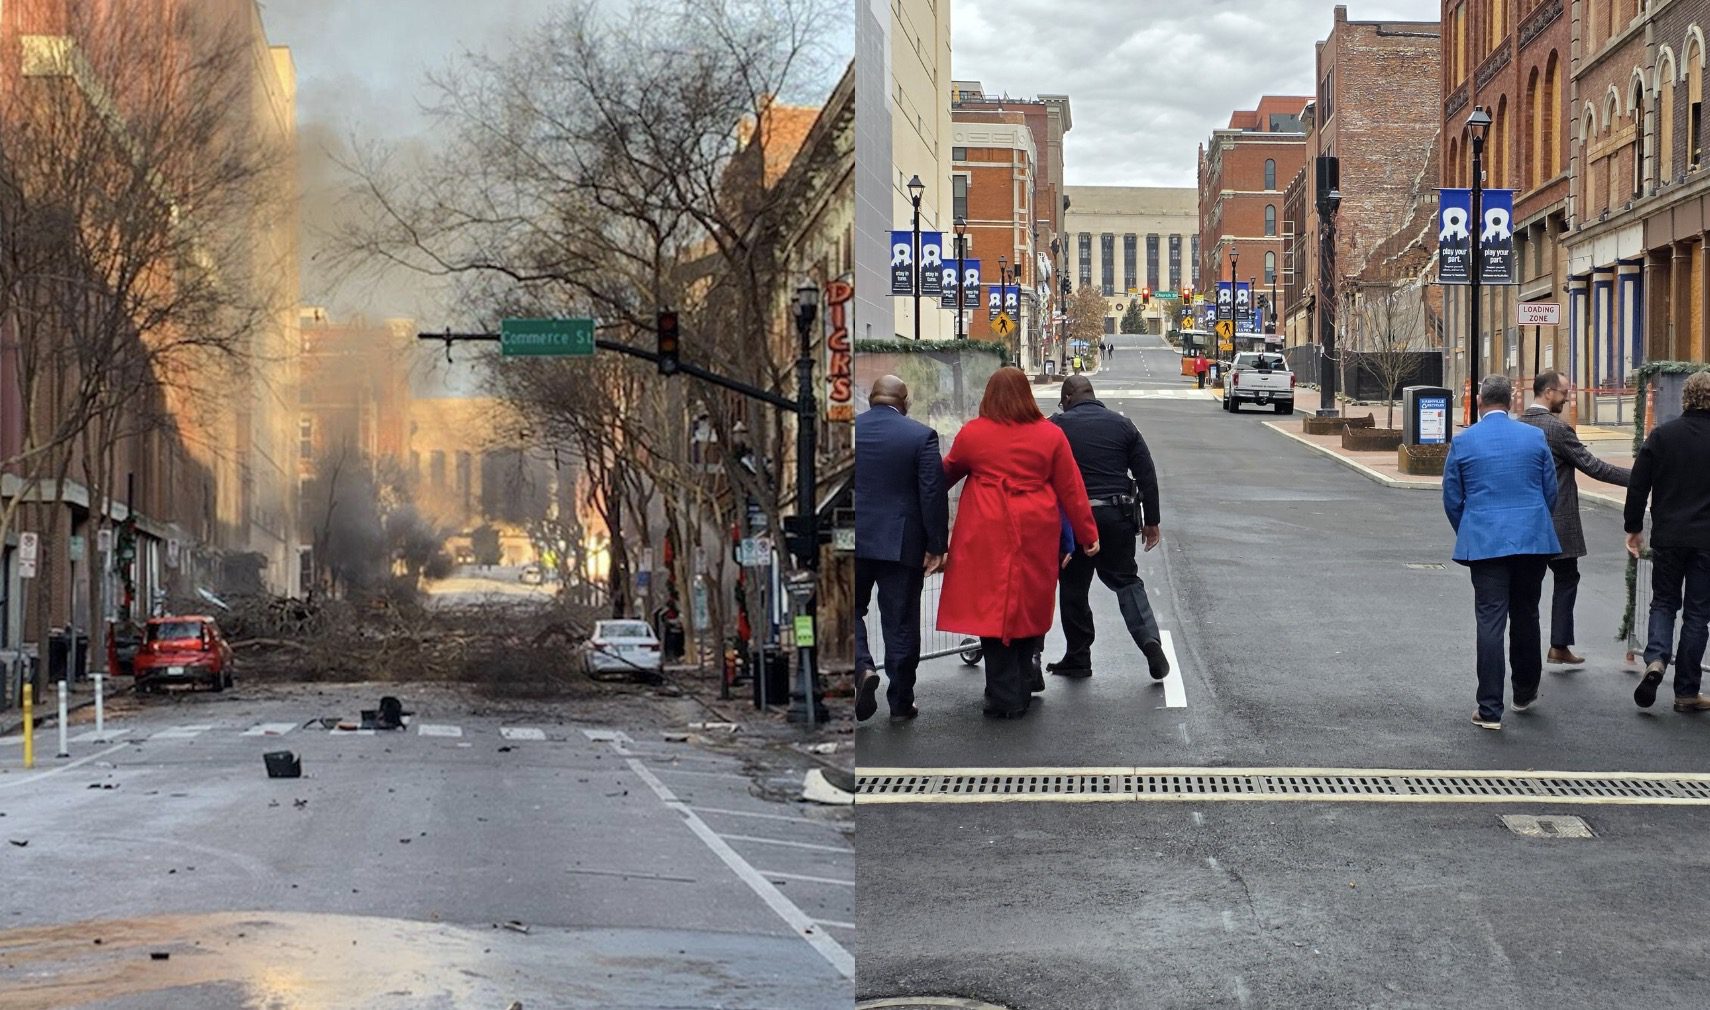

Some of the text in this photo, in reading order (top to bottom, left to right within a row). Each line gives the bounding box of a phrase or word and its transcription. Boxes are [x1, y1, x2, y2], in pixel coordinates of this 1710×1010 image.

[1442, 248, 1454, 256] play
[1484, 249, 1496, 257] play
[503, 331, 569, 345] Commerce
